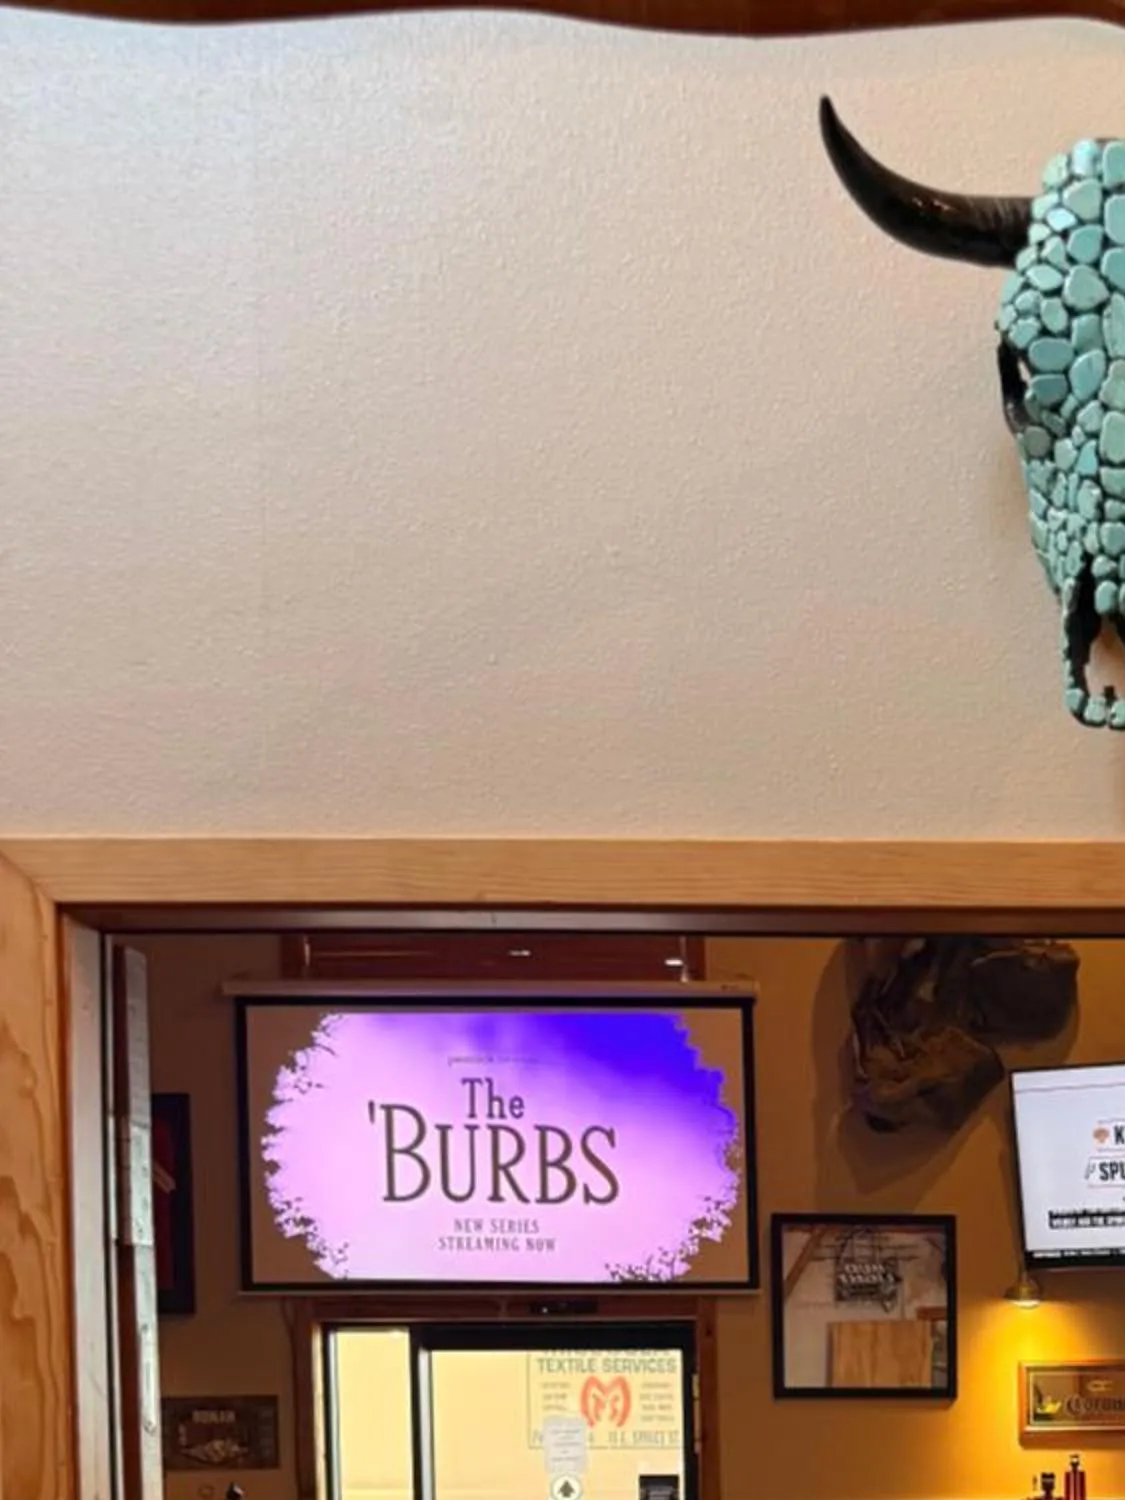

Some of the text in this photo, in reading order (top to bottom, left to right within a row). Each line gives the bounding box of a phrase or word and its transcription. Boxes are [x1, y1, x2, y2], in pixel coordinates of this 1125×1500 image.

[460, 1076, 525, 1119] The
[368, 1101, 620, 1205] 'BURBS
[453, 1218, 540, 1234] NEW SERIES
[438, 1235, 557, 1252] STREAMING NOW
[537, 1357, 676, 1374] TEXTILE SERVICES
